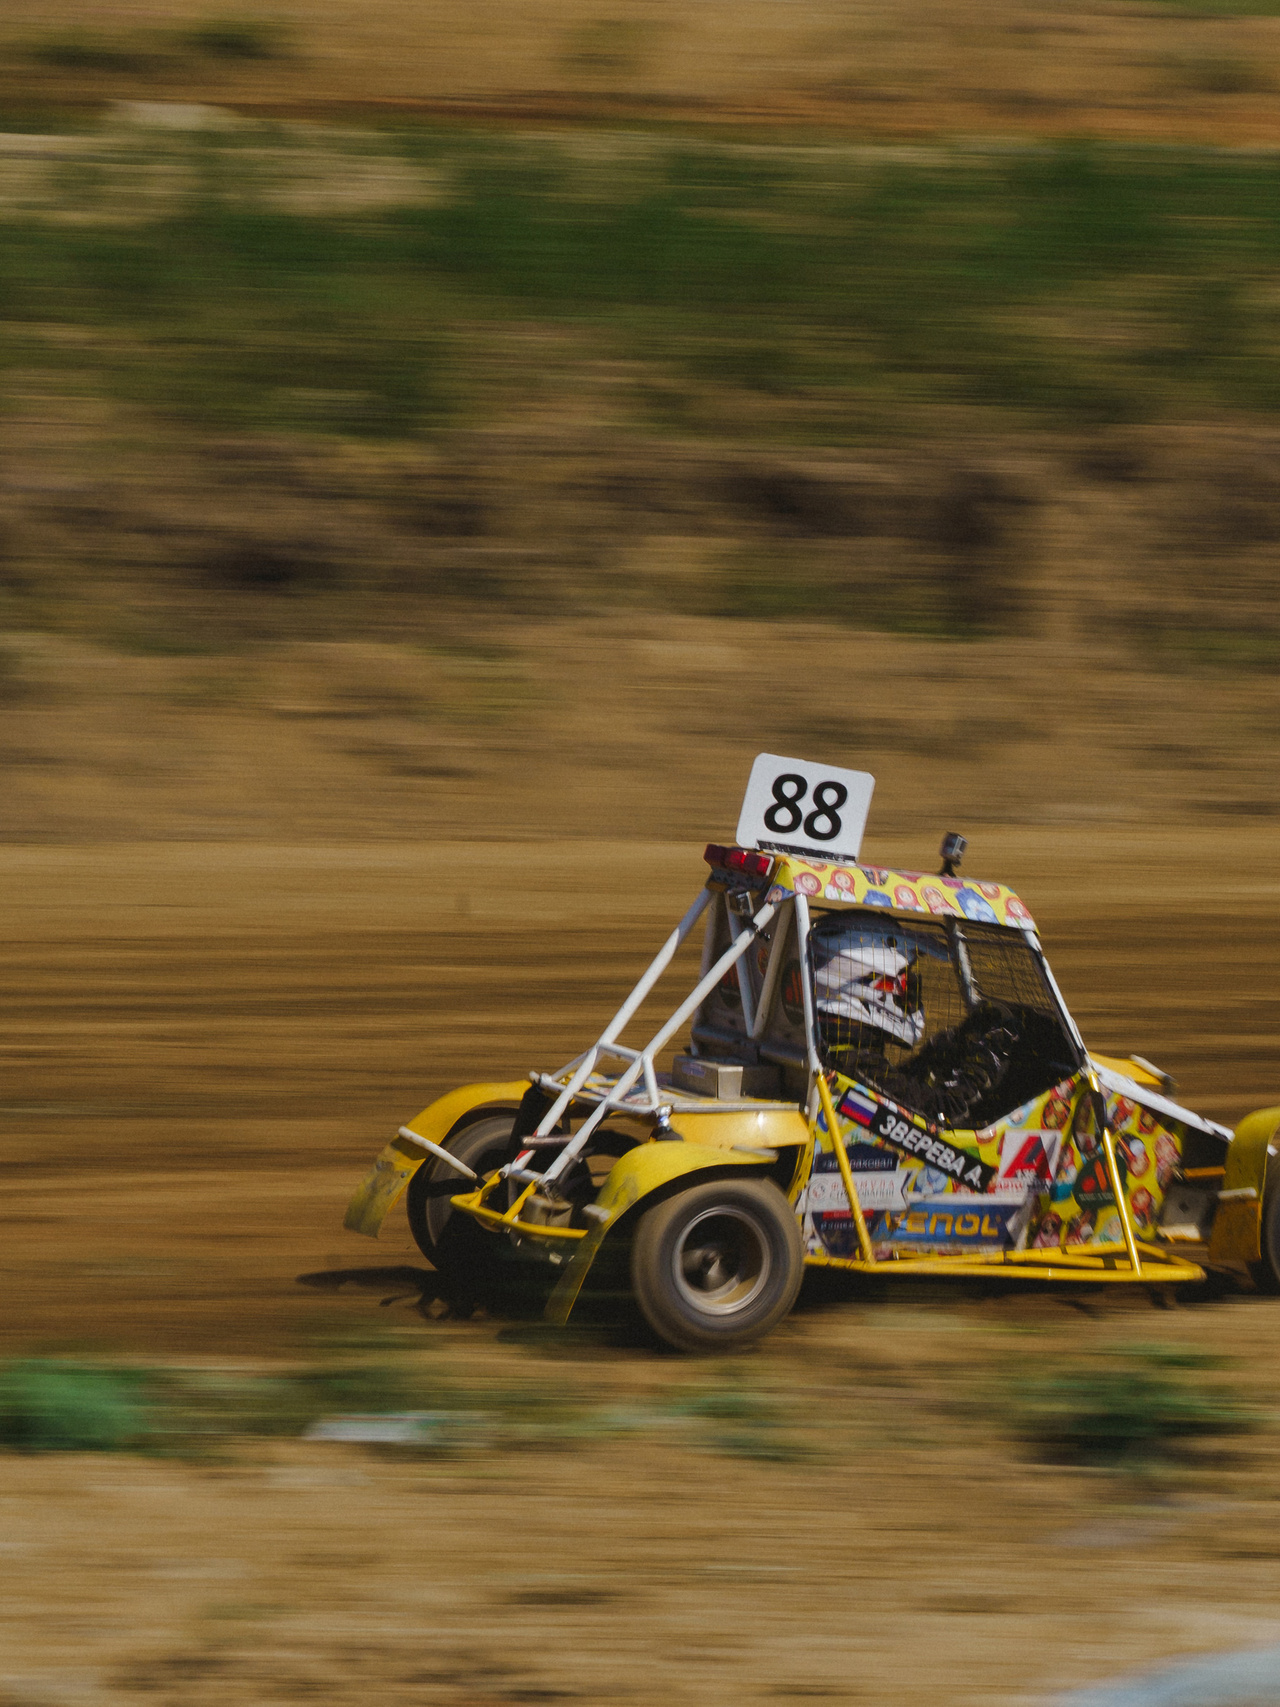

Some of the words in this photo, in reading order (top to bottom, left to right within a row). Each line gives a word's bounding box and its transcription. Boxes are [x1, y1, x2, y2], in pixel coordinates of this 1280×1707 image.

[763, 773, 848, 841] 88
[879, 1114, 966, 1177] ЗВЕРЕВА
[964, 1164, 984, 1189] А.
